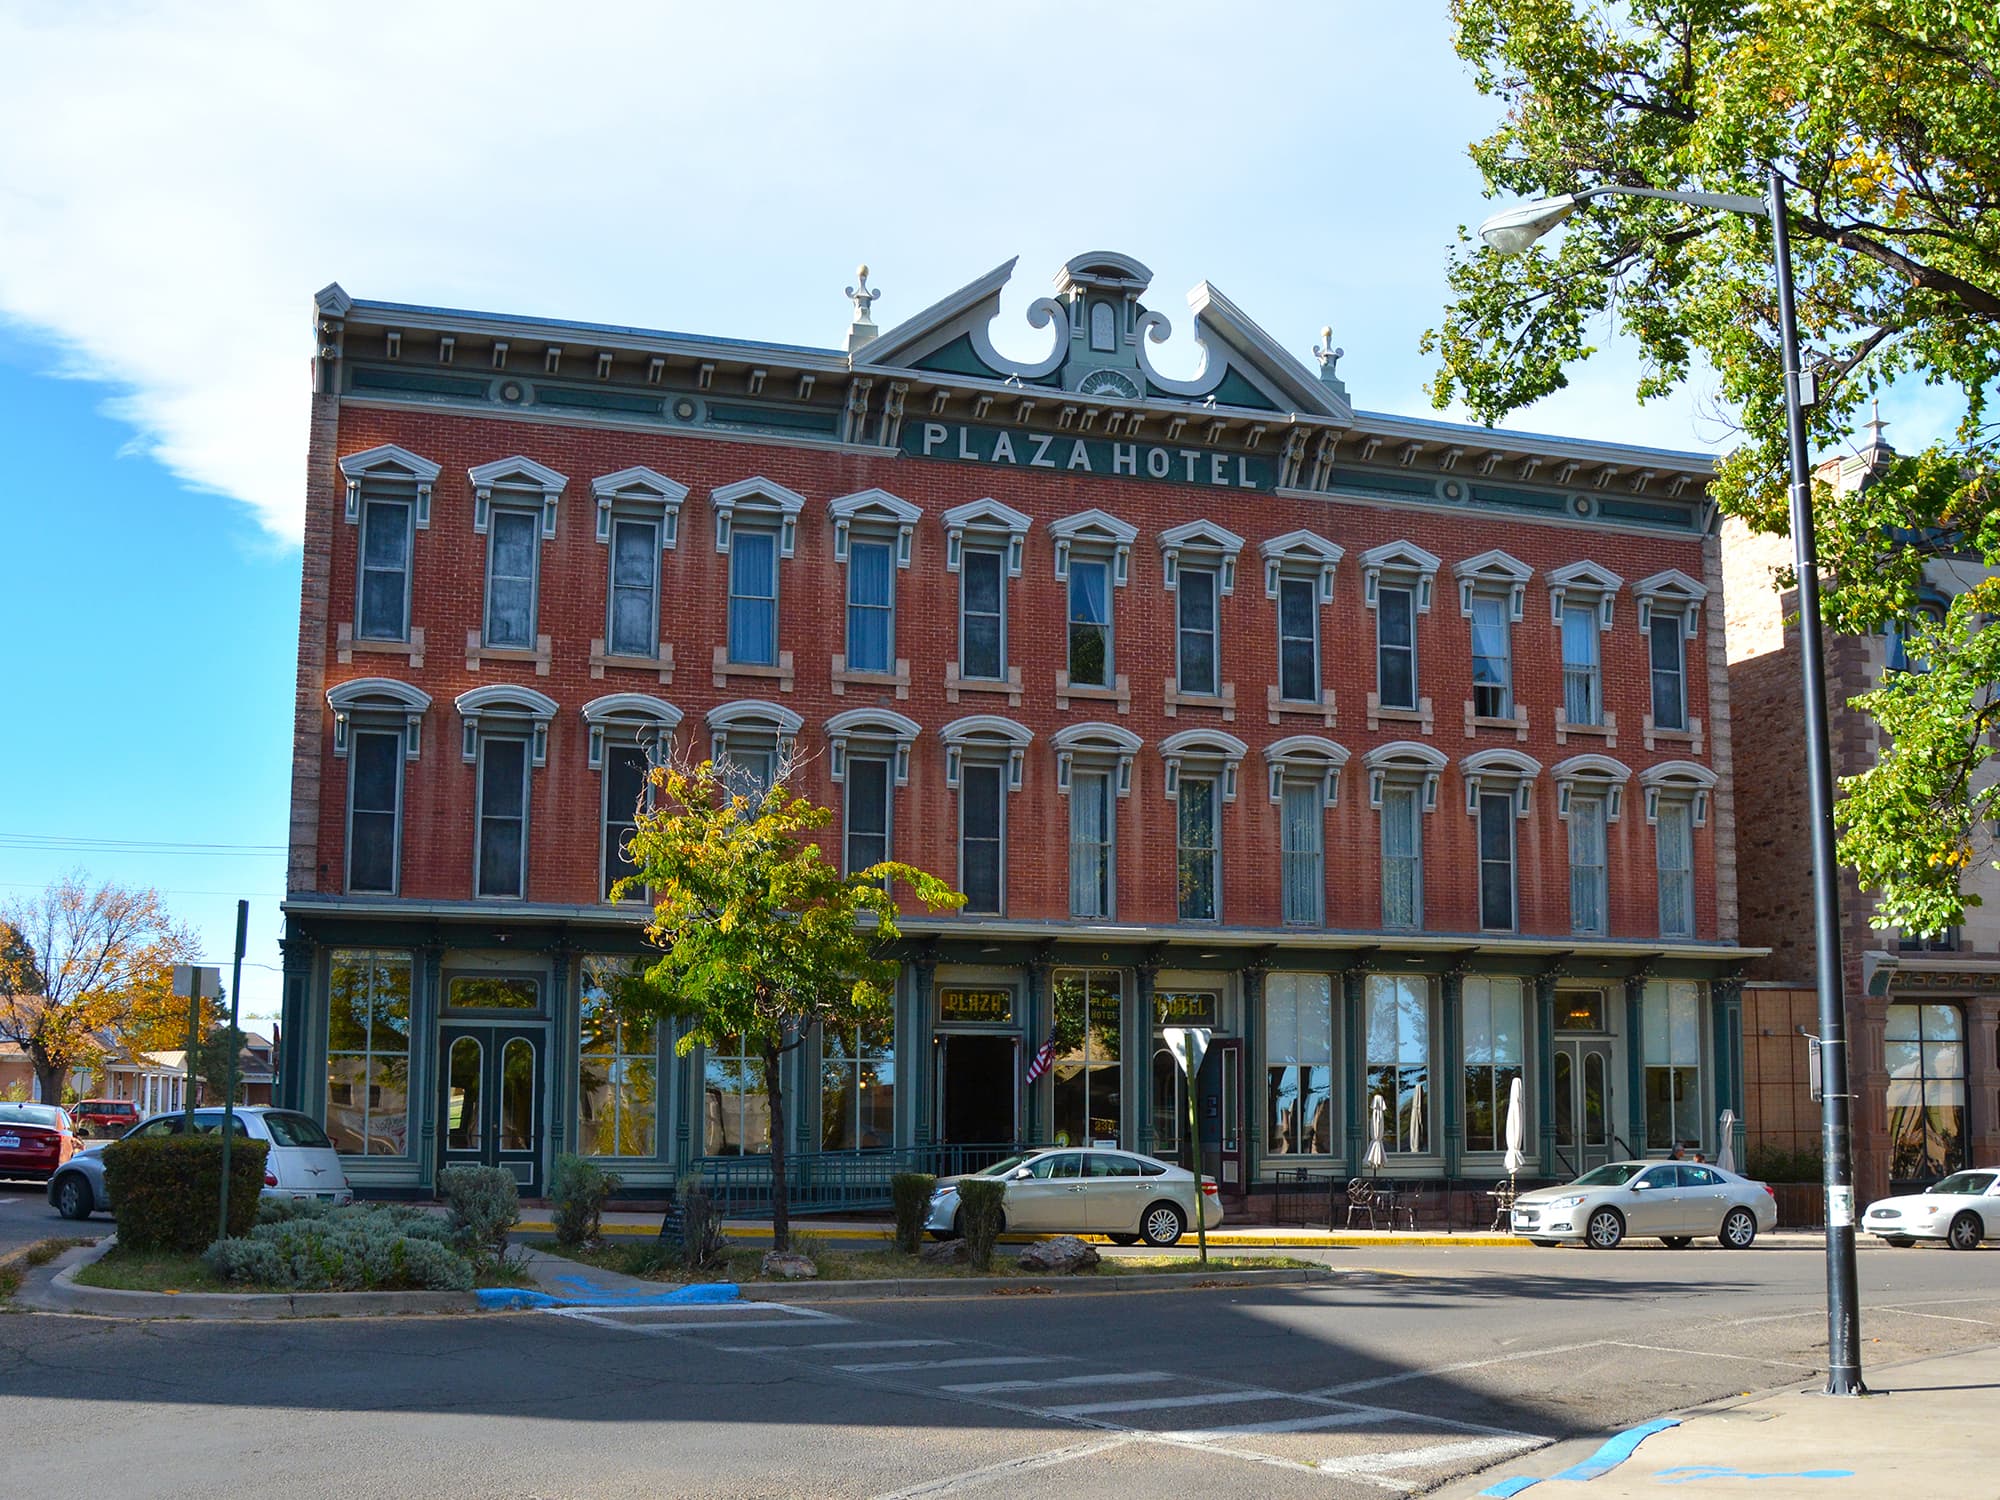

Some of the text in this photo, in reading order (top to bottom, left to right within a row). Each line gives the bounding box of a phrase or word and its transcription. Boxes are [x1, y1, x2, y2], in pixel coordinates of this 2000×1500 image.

[923, 423, 1257, 488] PLAZA HOTEL
[948, 993, 1001, 1012] PLAZA
[1157, 998, 1208, 1016] HOTEL
